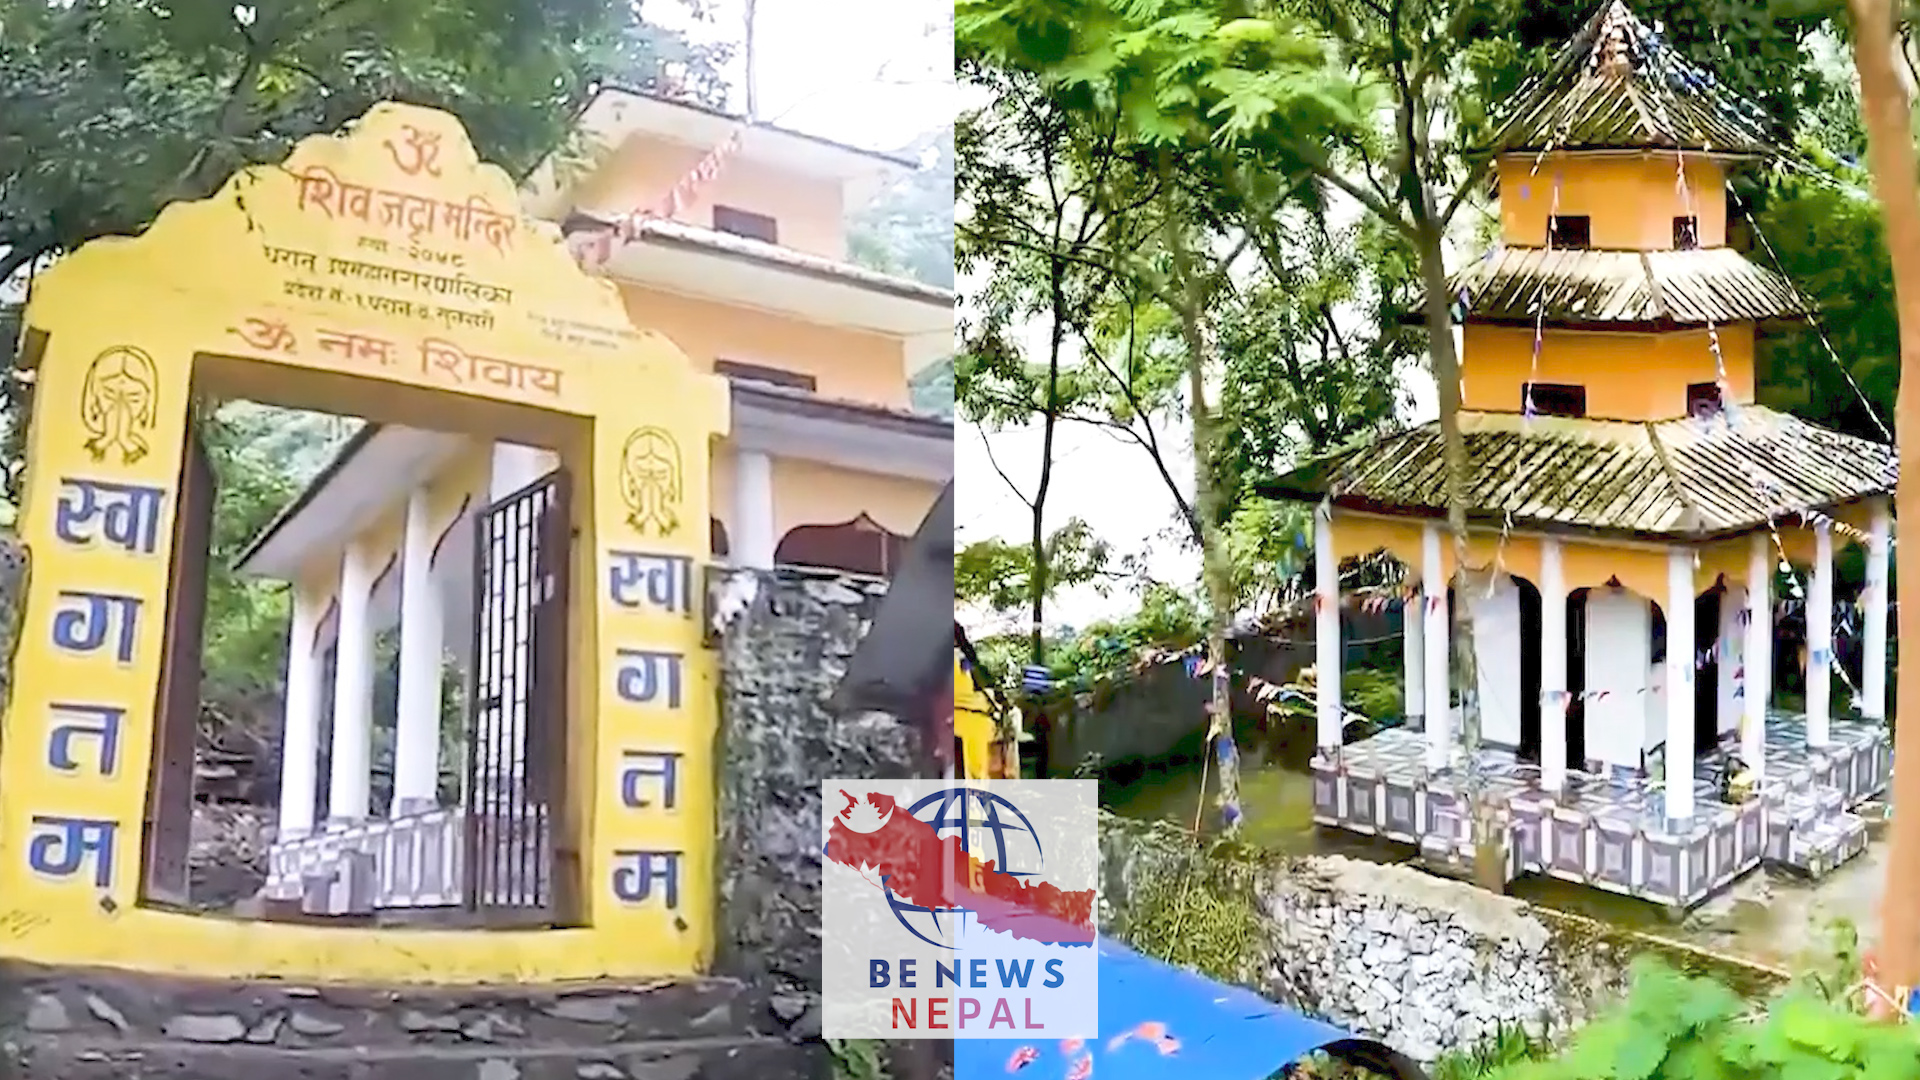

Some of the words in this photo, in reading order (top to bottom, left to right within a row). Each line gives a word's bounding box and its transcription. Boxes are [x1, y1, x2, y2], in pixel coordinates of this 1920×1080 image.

[298, 165, 374, 222] शिव
[443, 195, 517, 258] मन्दिर
[315, 327, 399, 366] नमः
[417, 335, 565, 397] शिवाय
